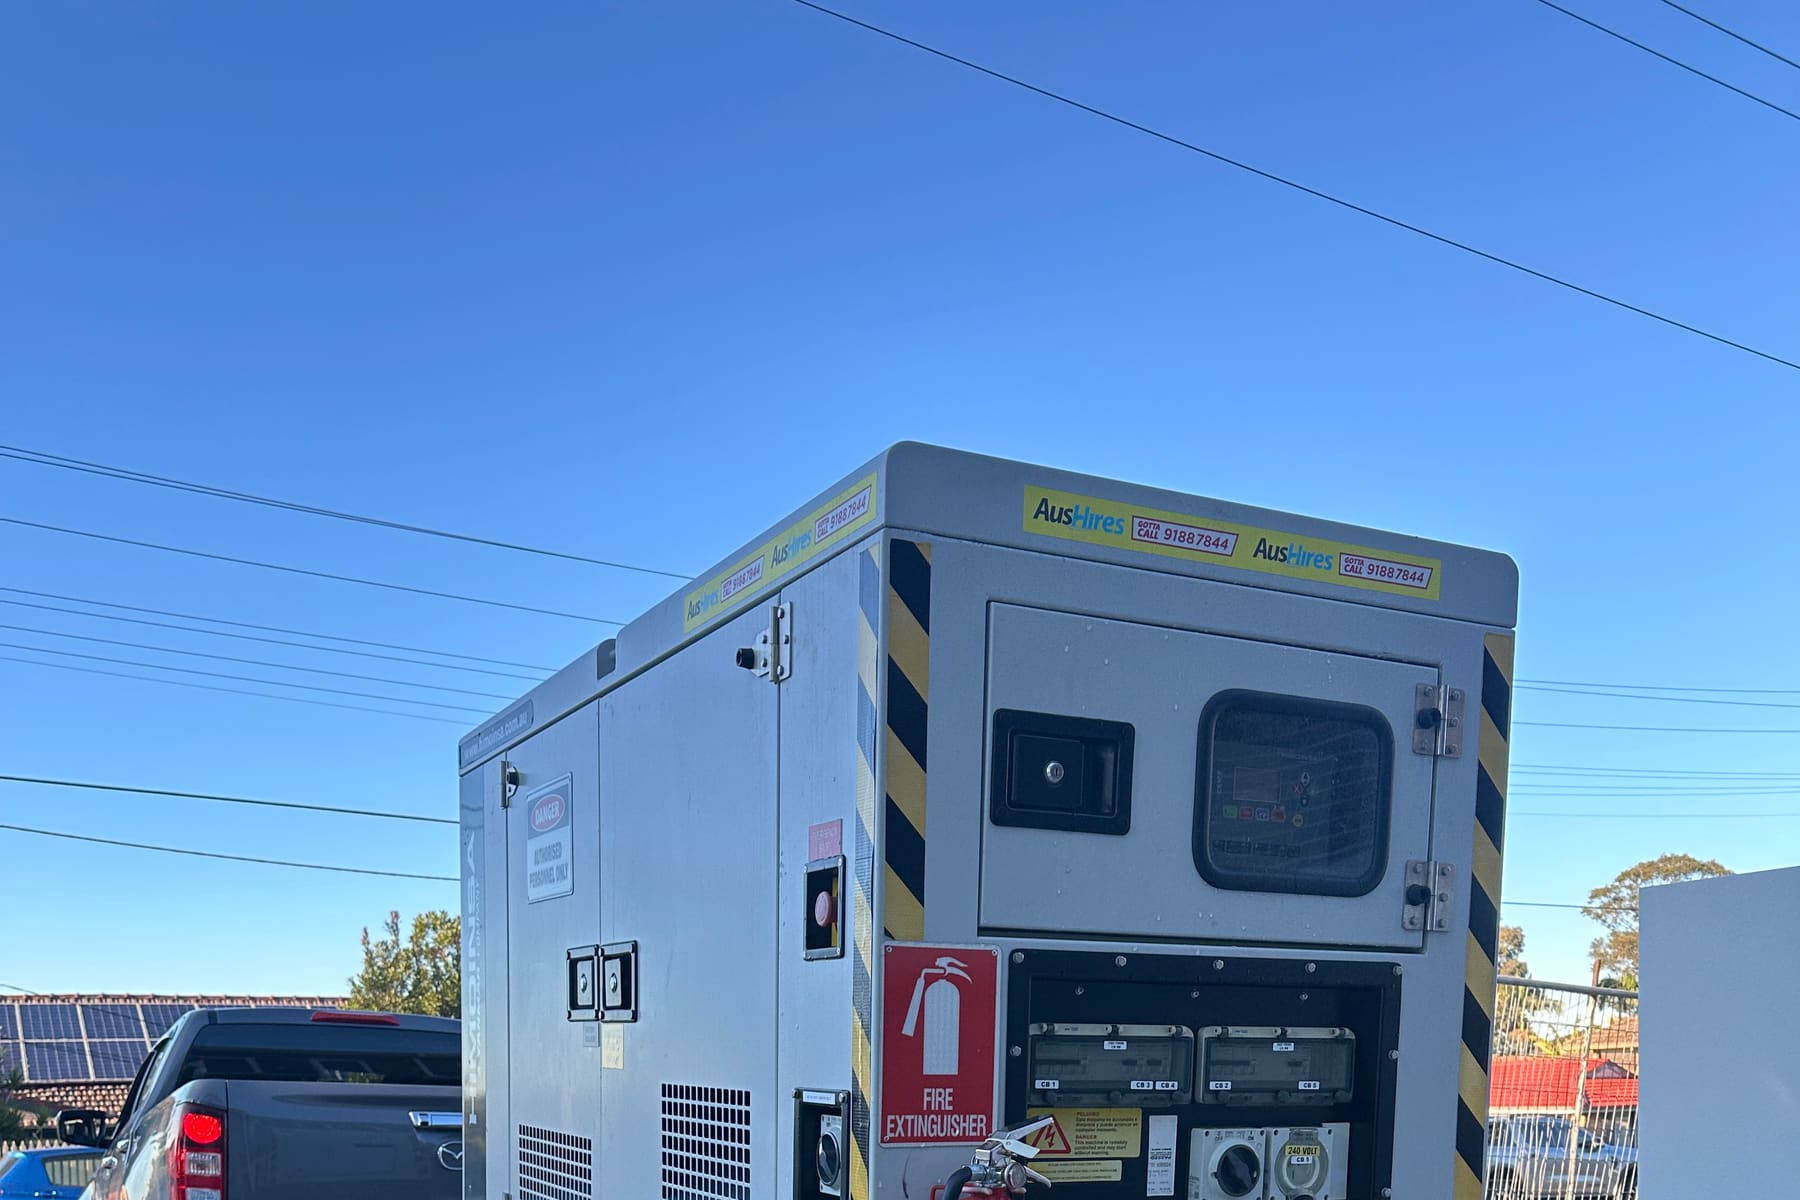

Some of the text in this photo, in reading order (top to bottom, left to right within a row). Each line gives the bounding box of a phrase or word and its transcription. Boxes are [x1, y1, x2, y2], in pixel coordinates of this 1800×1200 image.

[830, 495, 866, 529] 91887844
[1032, 497, 1125, 536] AusHires
[1136, 527, 1160, 541] CALL
[1137, 520, 1161, 531] GOTTA
[1163, 527, 1230, 551] 91887844
[1252, 537, 1334, 571] AusHires
[1343, 556, 1365, 567] GOTTA
[1343, 563, 1363, 575] CALL
[1367, 565, 1425, 584] 91887844
[535, 801, 560, 825] DANGER
[556, 862, 569, 881] ONLY
[923, 1088, 953, 1110] FIRE
[886, 1114, 987, 1137] EXTINGUISHER
[1287, 1147, 1318, 1155] 240 VOLT
